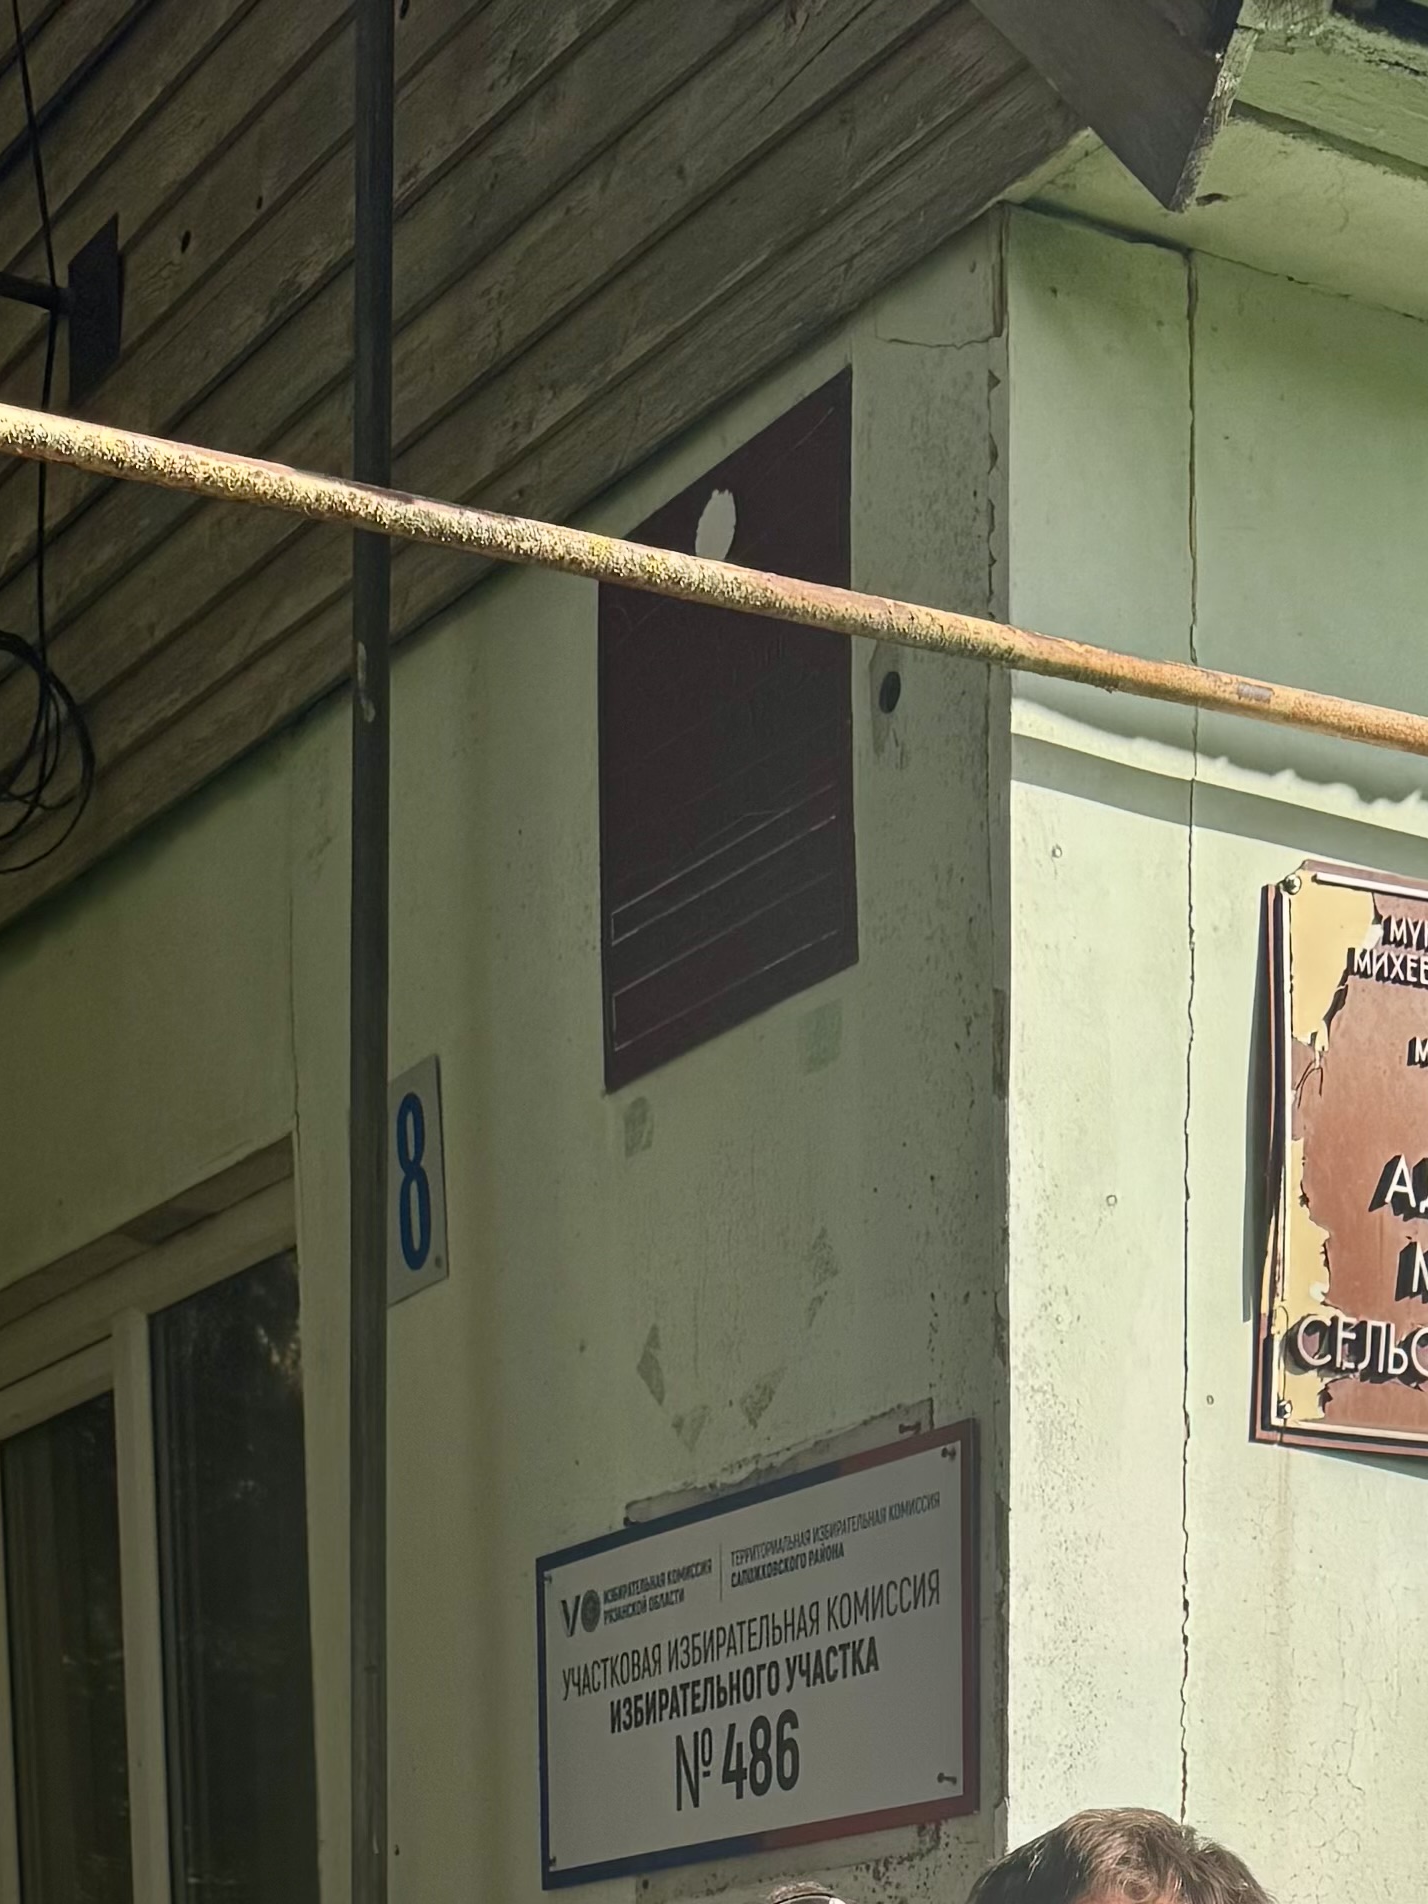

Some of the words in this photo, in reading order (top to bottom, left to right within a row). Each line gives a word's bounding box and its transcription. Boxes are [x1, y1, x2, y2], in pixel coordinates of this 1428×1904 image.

[396, 1092, 431, 1270] 8
[808, 1542, 845, 1567] РАЙОНА
[812, 1508, 887, 1545] ИЗБИРАТЕЛЬНАЯ
[888, 1491, 941, 1521] КОМИССИЯ
[562, 1643, 662, 1701] УЧАСТКОВАЯ
[668, 1600, 820, 1672] ИЗБИРАТЕЛЬНАЯ
[827, 1567, 941, 1632] КОМИССИЯ
[609, 1660, 780, 1734] ИЗБИРАТЕЛЬНОГО
[785, 1635, 880, 1693] УЧАСТКА
[675, 1727, 713, 1812] №
[721, 1708, 800, 1800] 486
